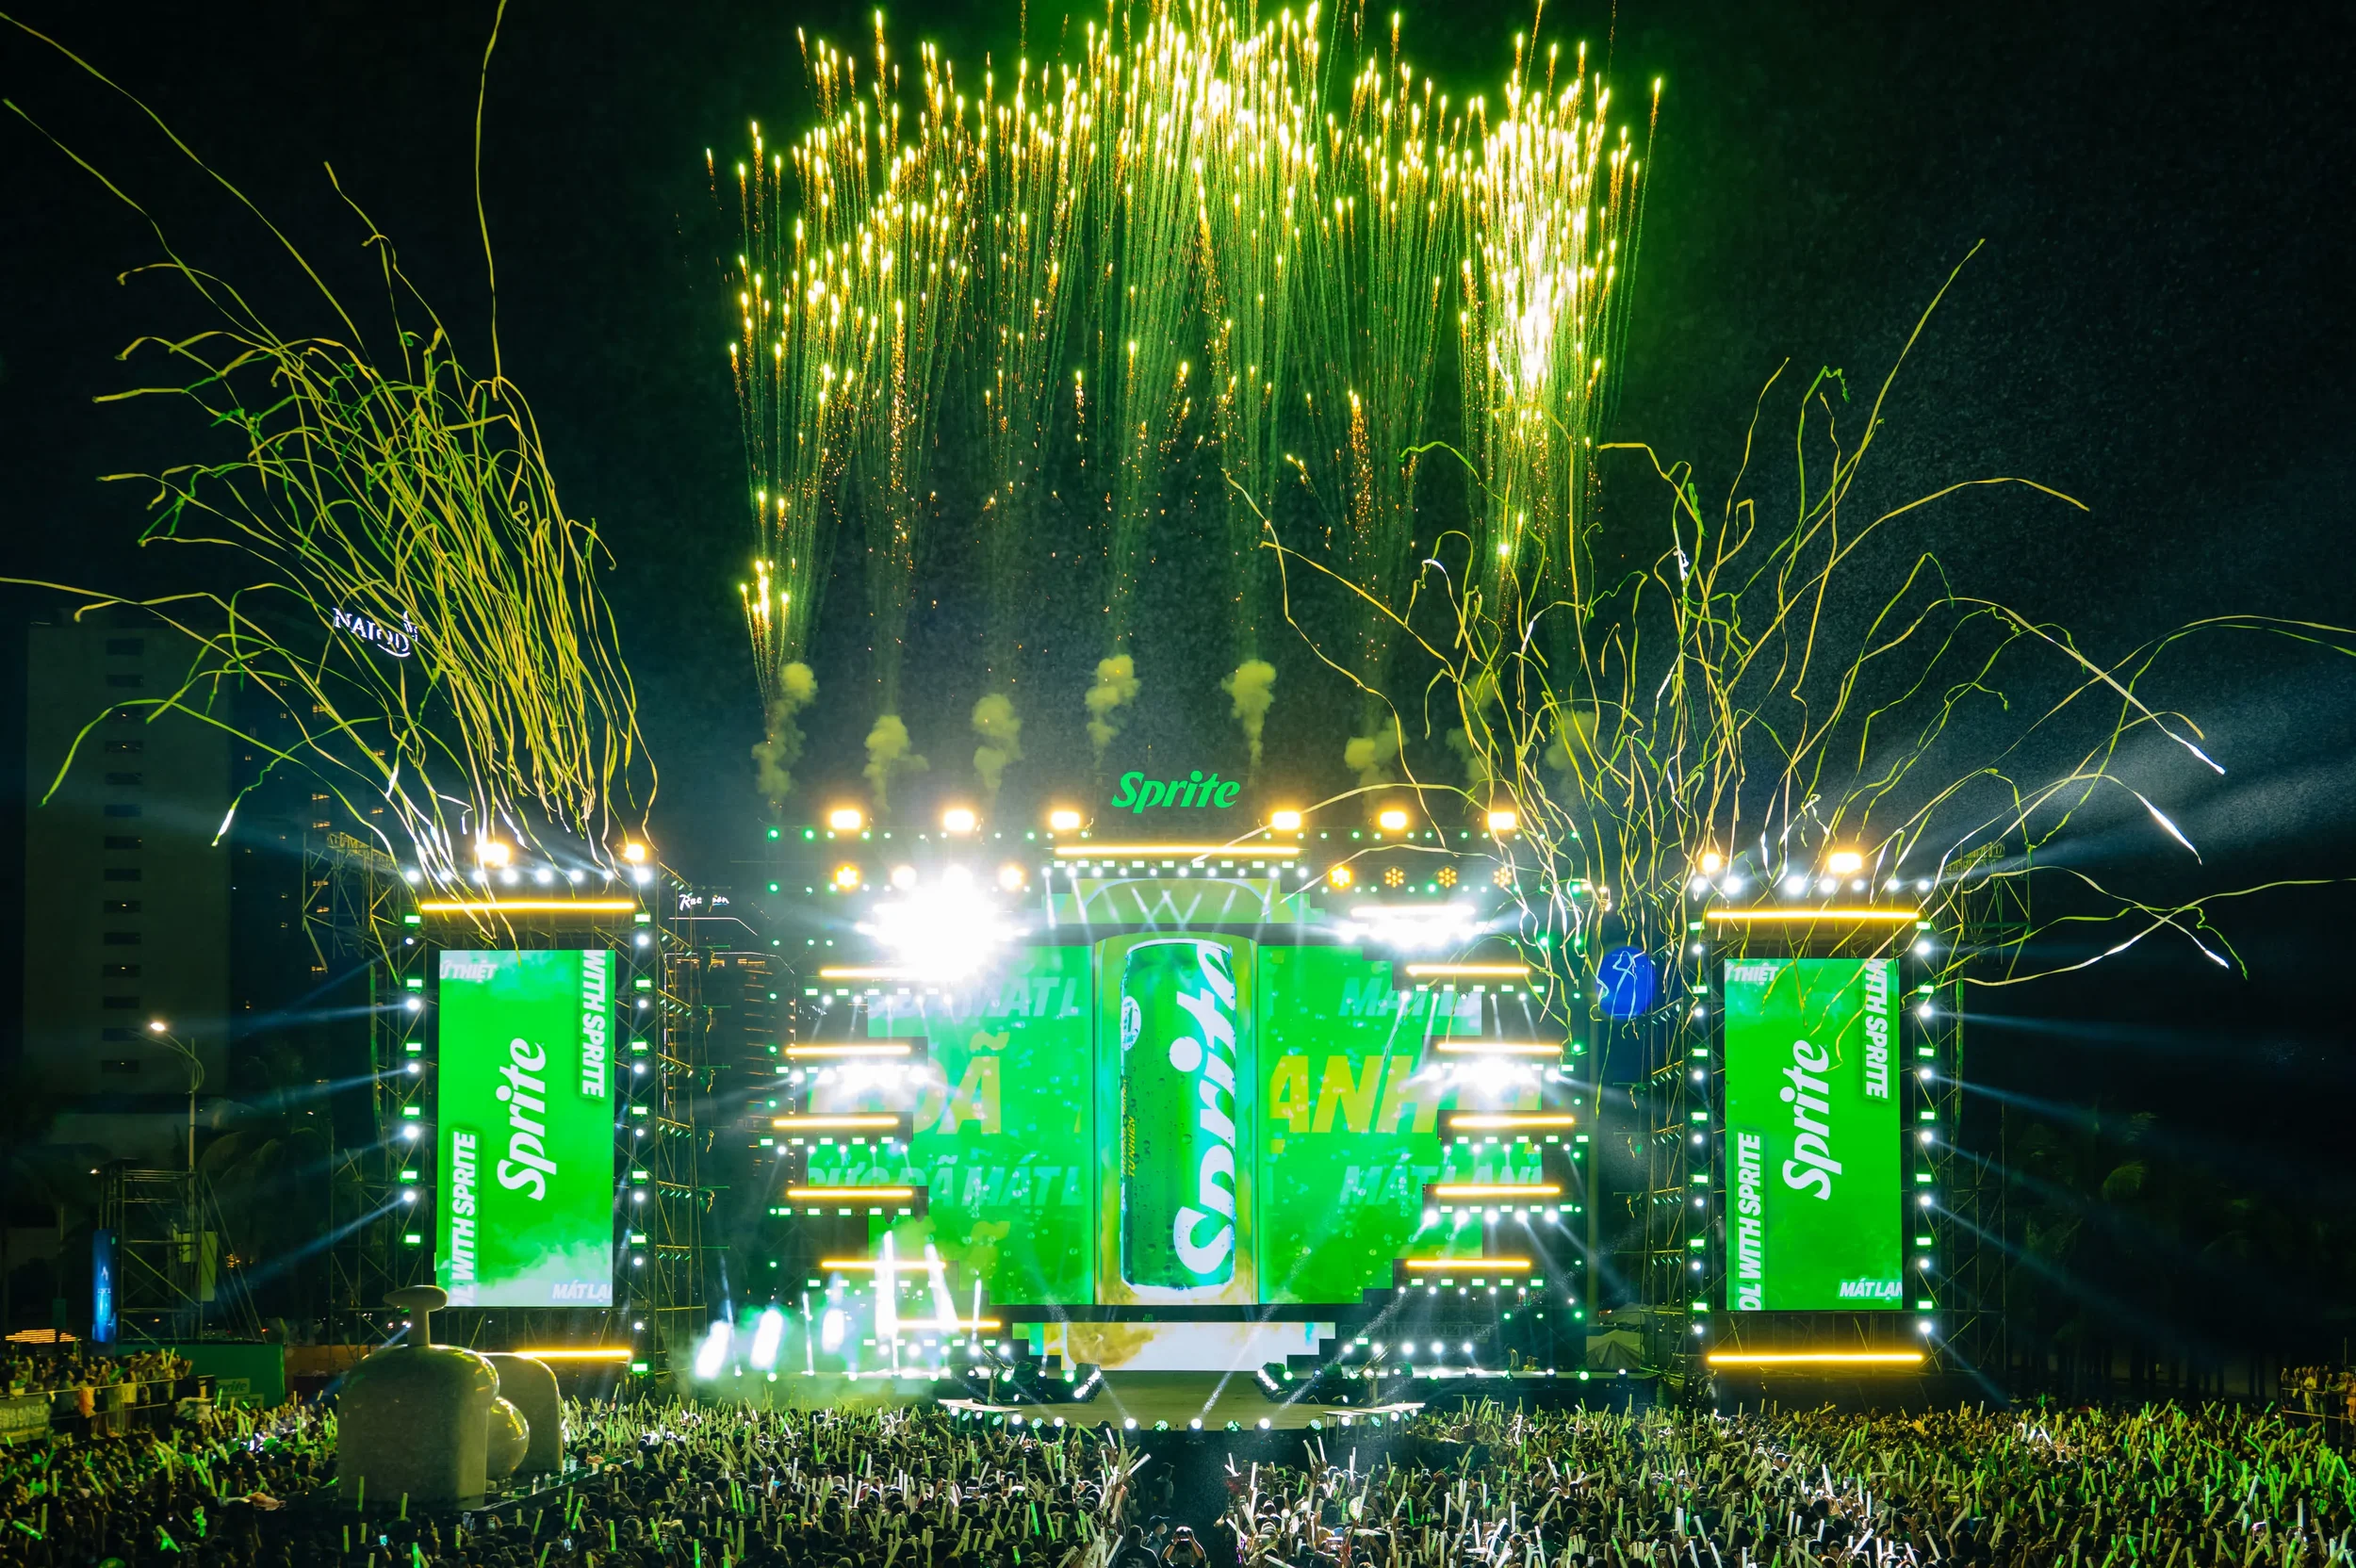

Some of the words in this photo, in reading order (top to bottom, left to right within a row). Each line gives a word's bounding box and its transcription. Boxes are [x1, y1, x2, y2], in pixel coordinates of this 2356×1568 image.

[1111, 770, 1241, 814] Sprite
[582, 950, 606, 1012] WITH
[1734, 962, 1779, 986] THIỆT
[582, 1013, 605, 1098] SPRITE
[1865, 1016, 1888, 1099] SPRITE
[496, 1037, 557, 1200] Sprite
[1779, 1039, 1842, 1200] Sprite
[453, 1132, 476, 1216] SPRITE
[1738, 1133, 1760, 1217] SPRITE
[451, 1219, 475, 1280] WITH
[1739, 1217, 1761, 1279] WITH
[552, 1280, 588, 1299] MÁT
[1839, 1278, 1875, 1297] MÁT
